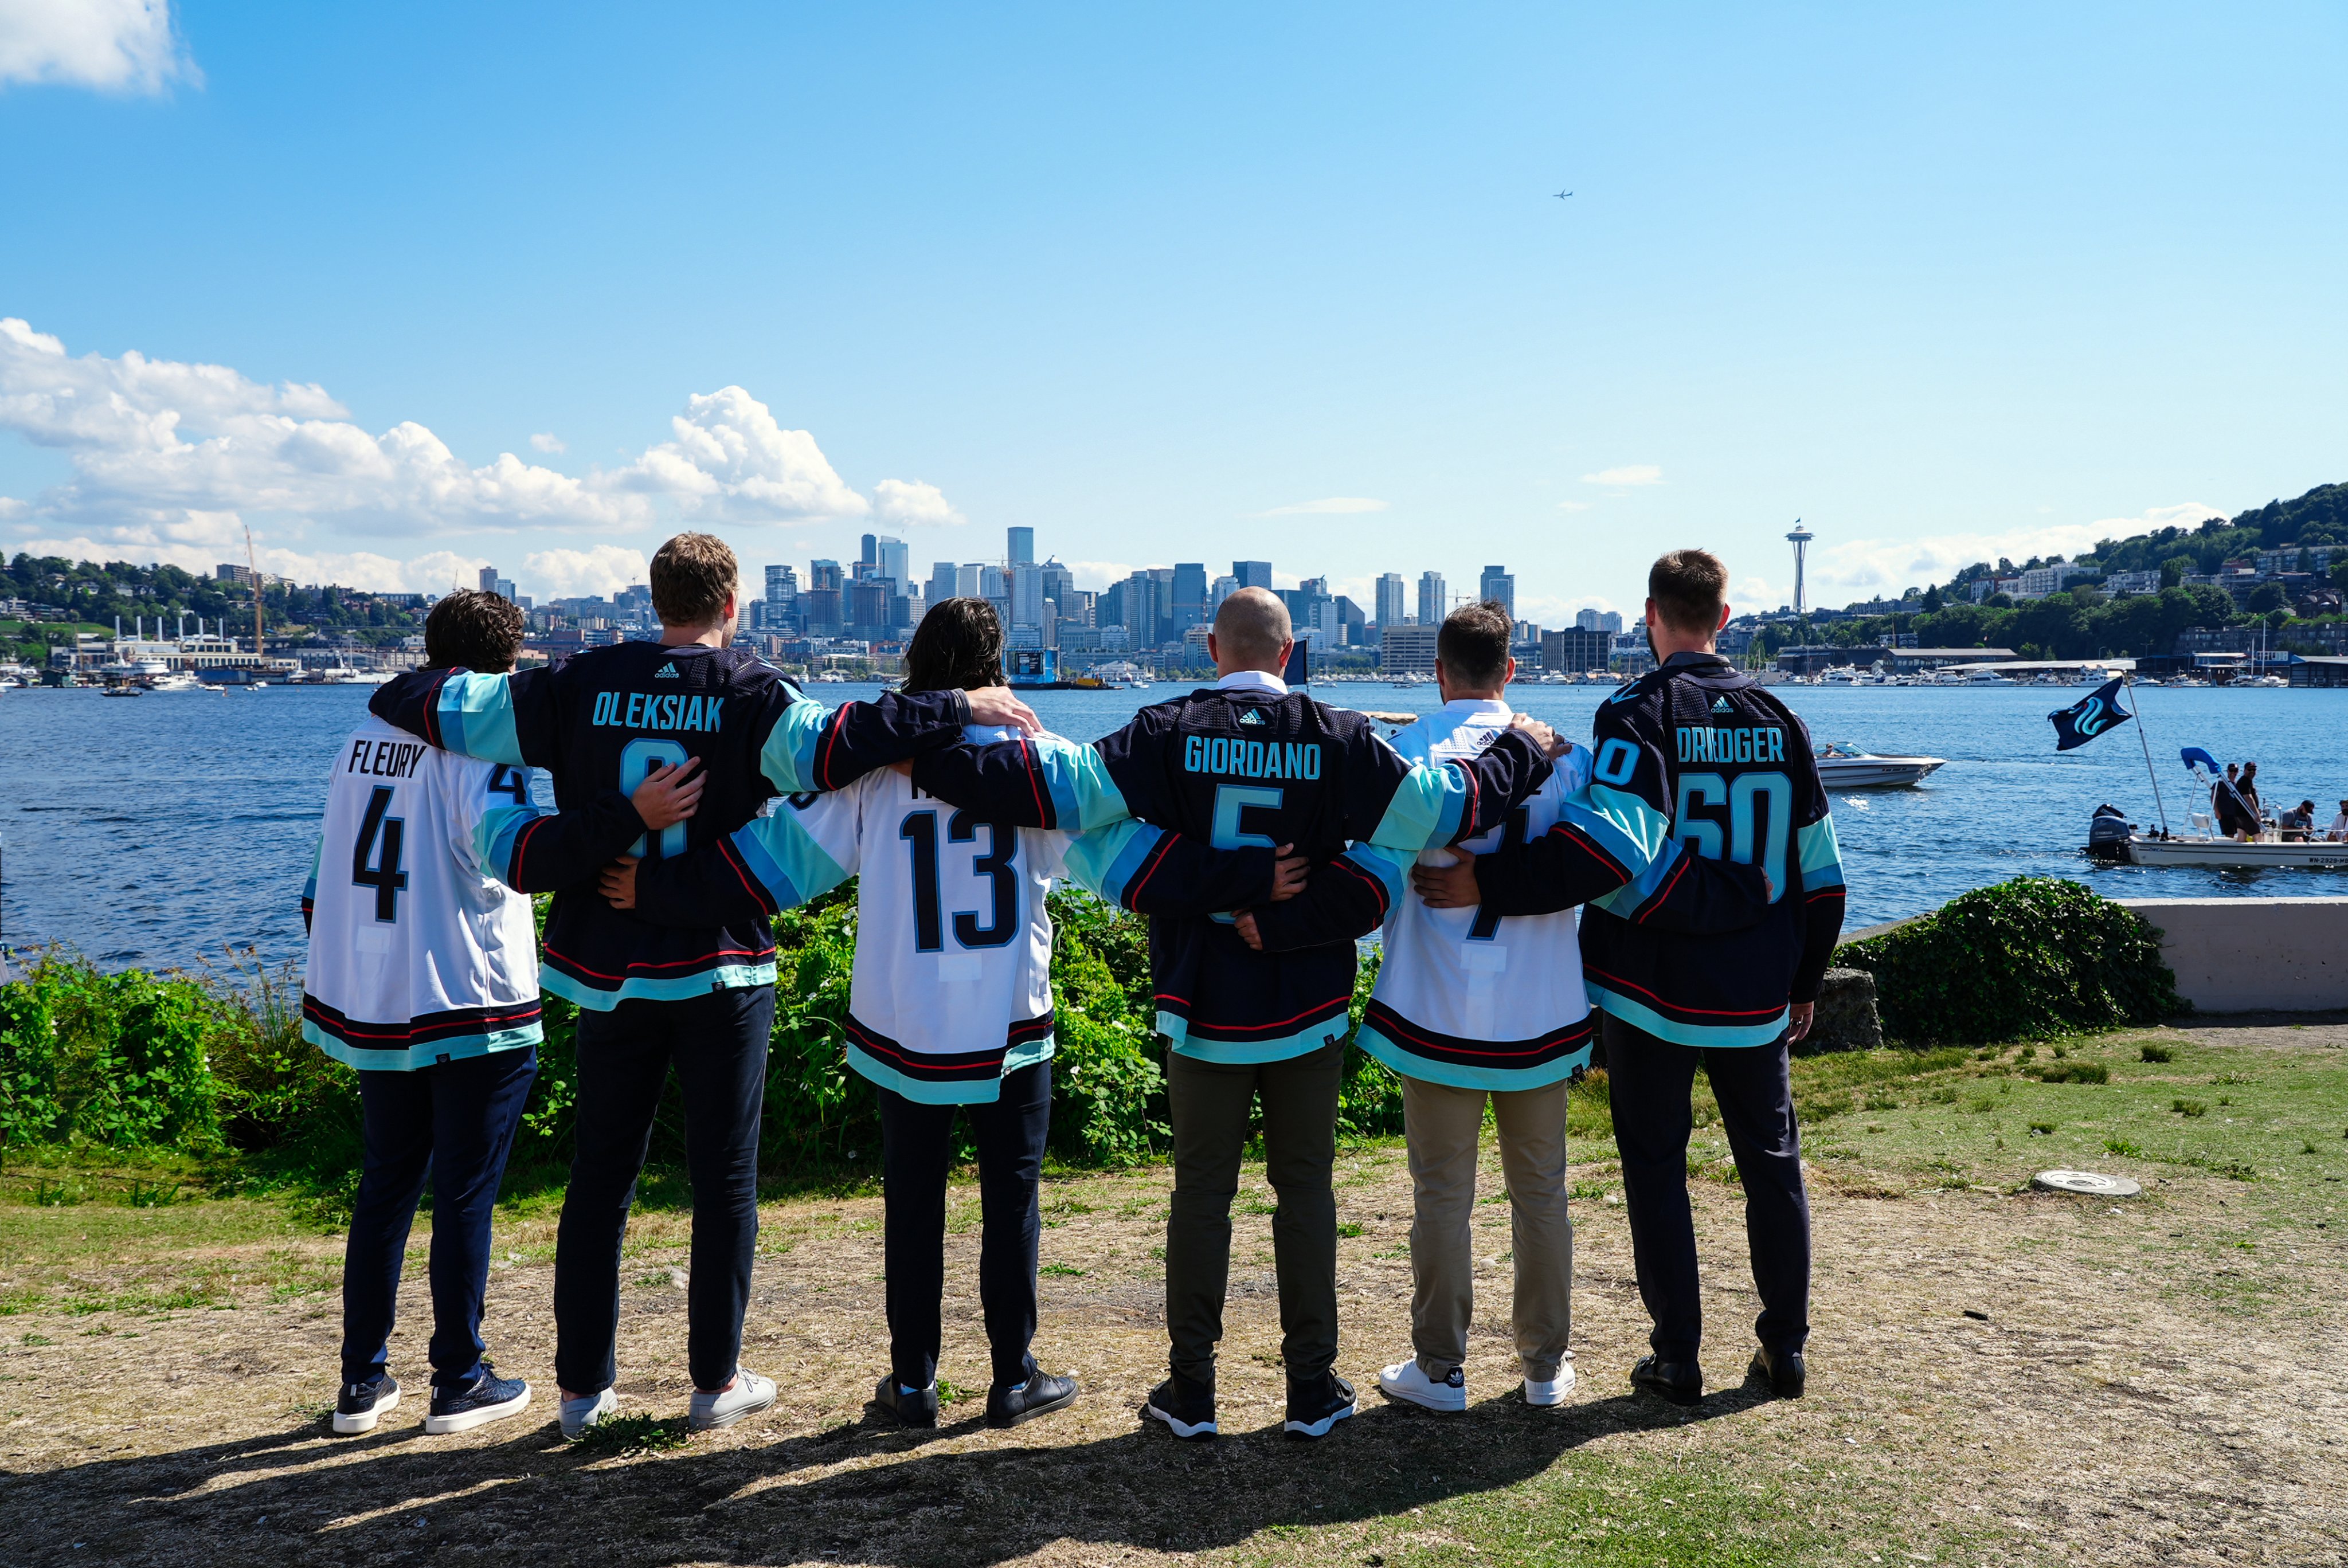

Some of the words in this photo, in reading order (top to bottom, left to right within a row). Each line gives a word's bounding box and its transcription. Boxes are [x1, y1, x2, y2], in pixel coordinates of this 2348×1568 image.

[592, 692, 725, 732] OLEKSIAK
[1239, 717, 1266, 725] adidas
[348, 740, 427, 778] FLEURY
[1184, 735, 1321, 780] GIORDANO
[1594, 735, 1641, 786] 0
[487, 763, 527, 806] 4
[351, 785, 409, 924] 4
[1673, 771, 1793, 904] 60
[899, 809, 1020, 953] 13
